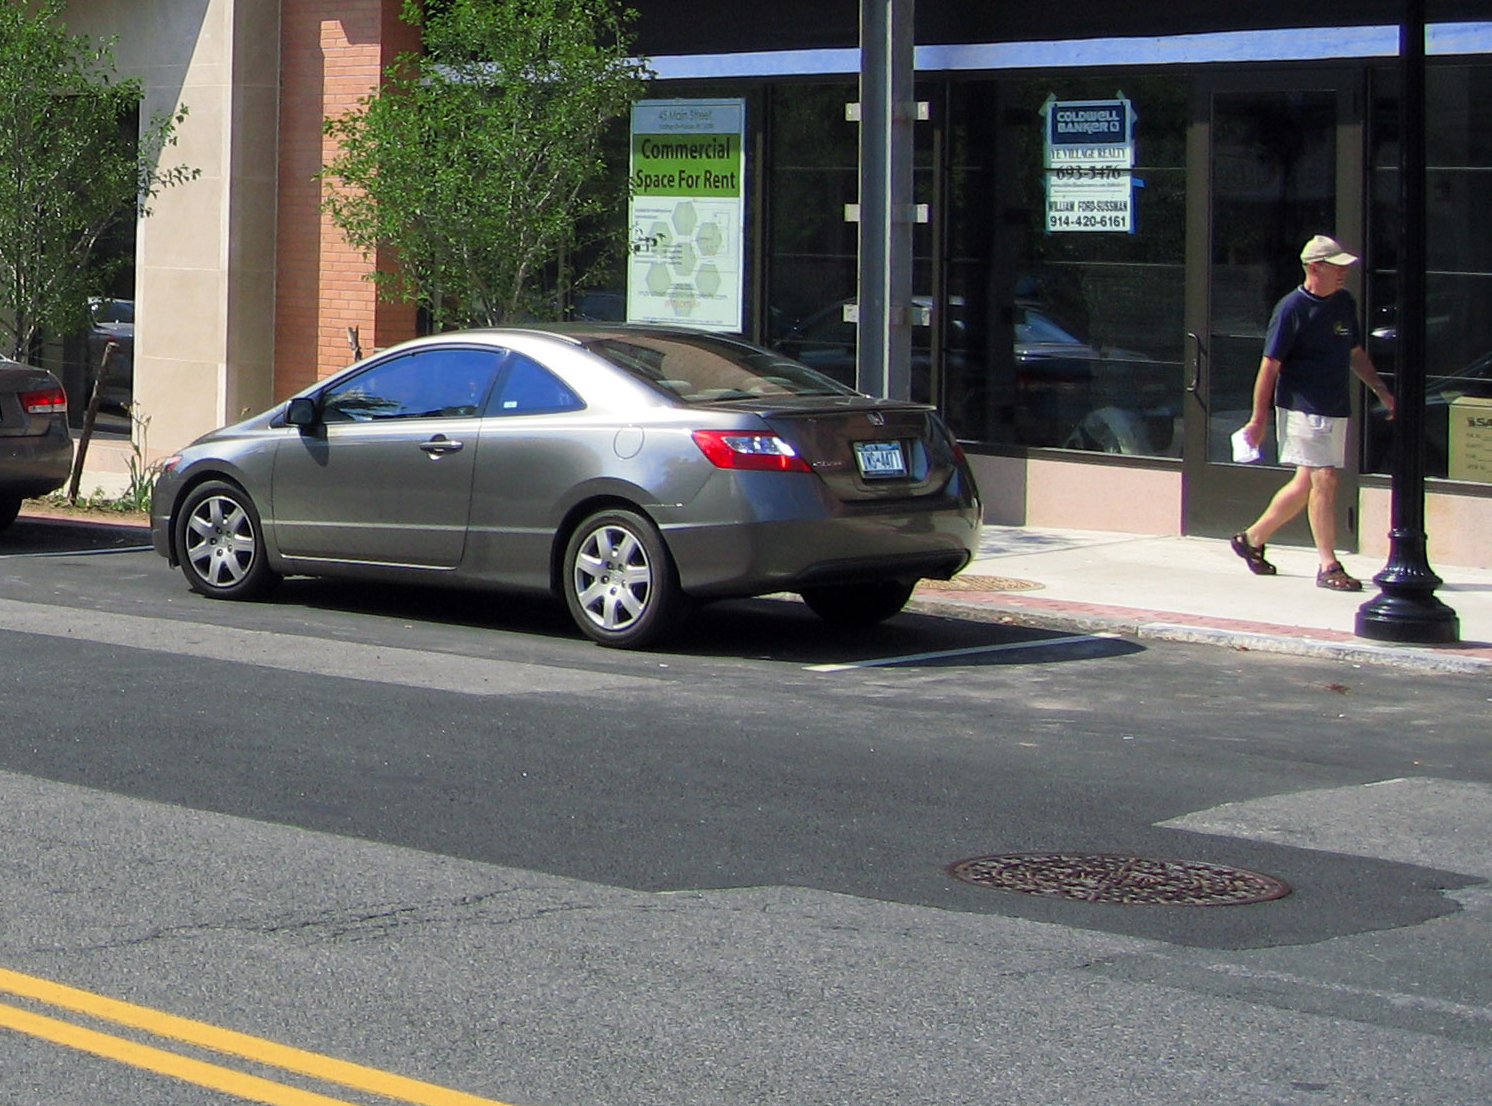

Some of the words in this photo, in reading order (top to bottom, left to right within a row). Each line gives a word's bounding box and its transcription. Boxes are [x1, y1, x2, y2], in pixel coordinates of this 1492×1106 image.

[659, 109, 668, 121] 45
[670, 109, 687, 120] Main
[690, 109, 713, 121] Street
[641, 137, 731, 159] Commercial
[1063, 148, 1095, 159] VILLAGE
[1097, 147, 1126, 159] REALTY
[636, 169, 675, 193] Space
[678, 170, 700, 189] For
[703, 170, 736, 189] Rent
[1049, 200, 1075, 212] WILLIAM
[1078, 200, 1128, 212] FORD-SUSSMAN
[1050, 215, 1126, 228] 914-420-6161
